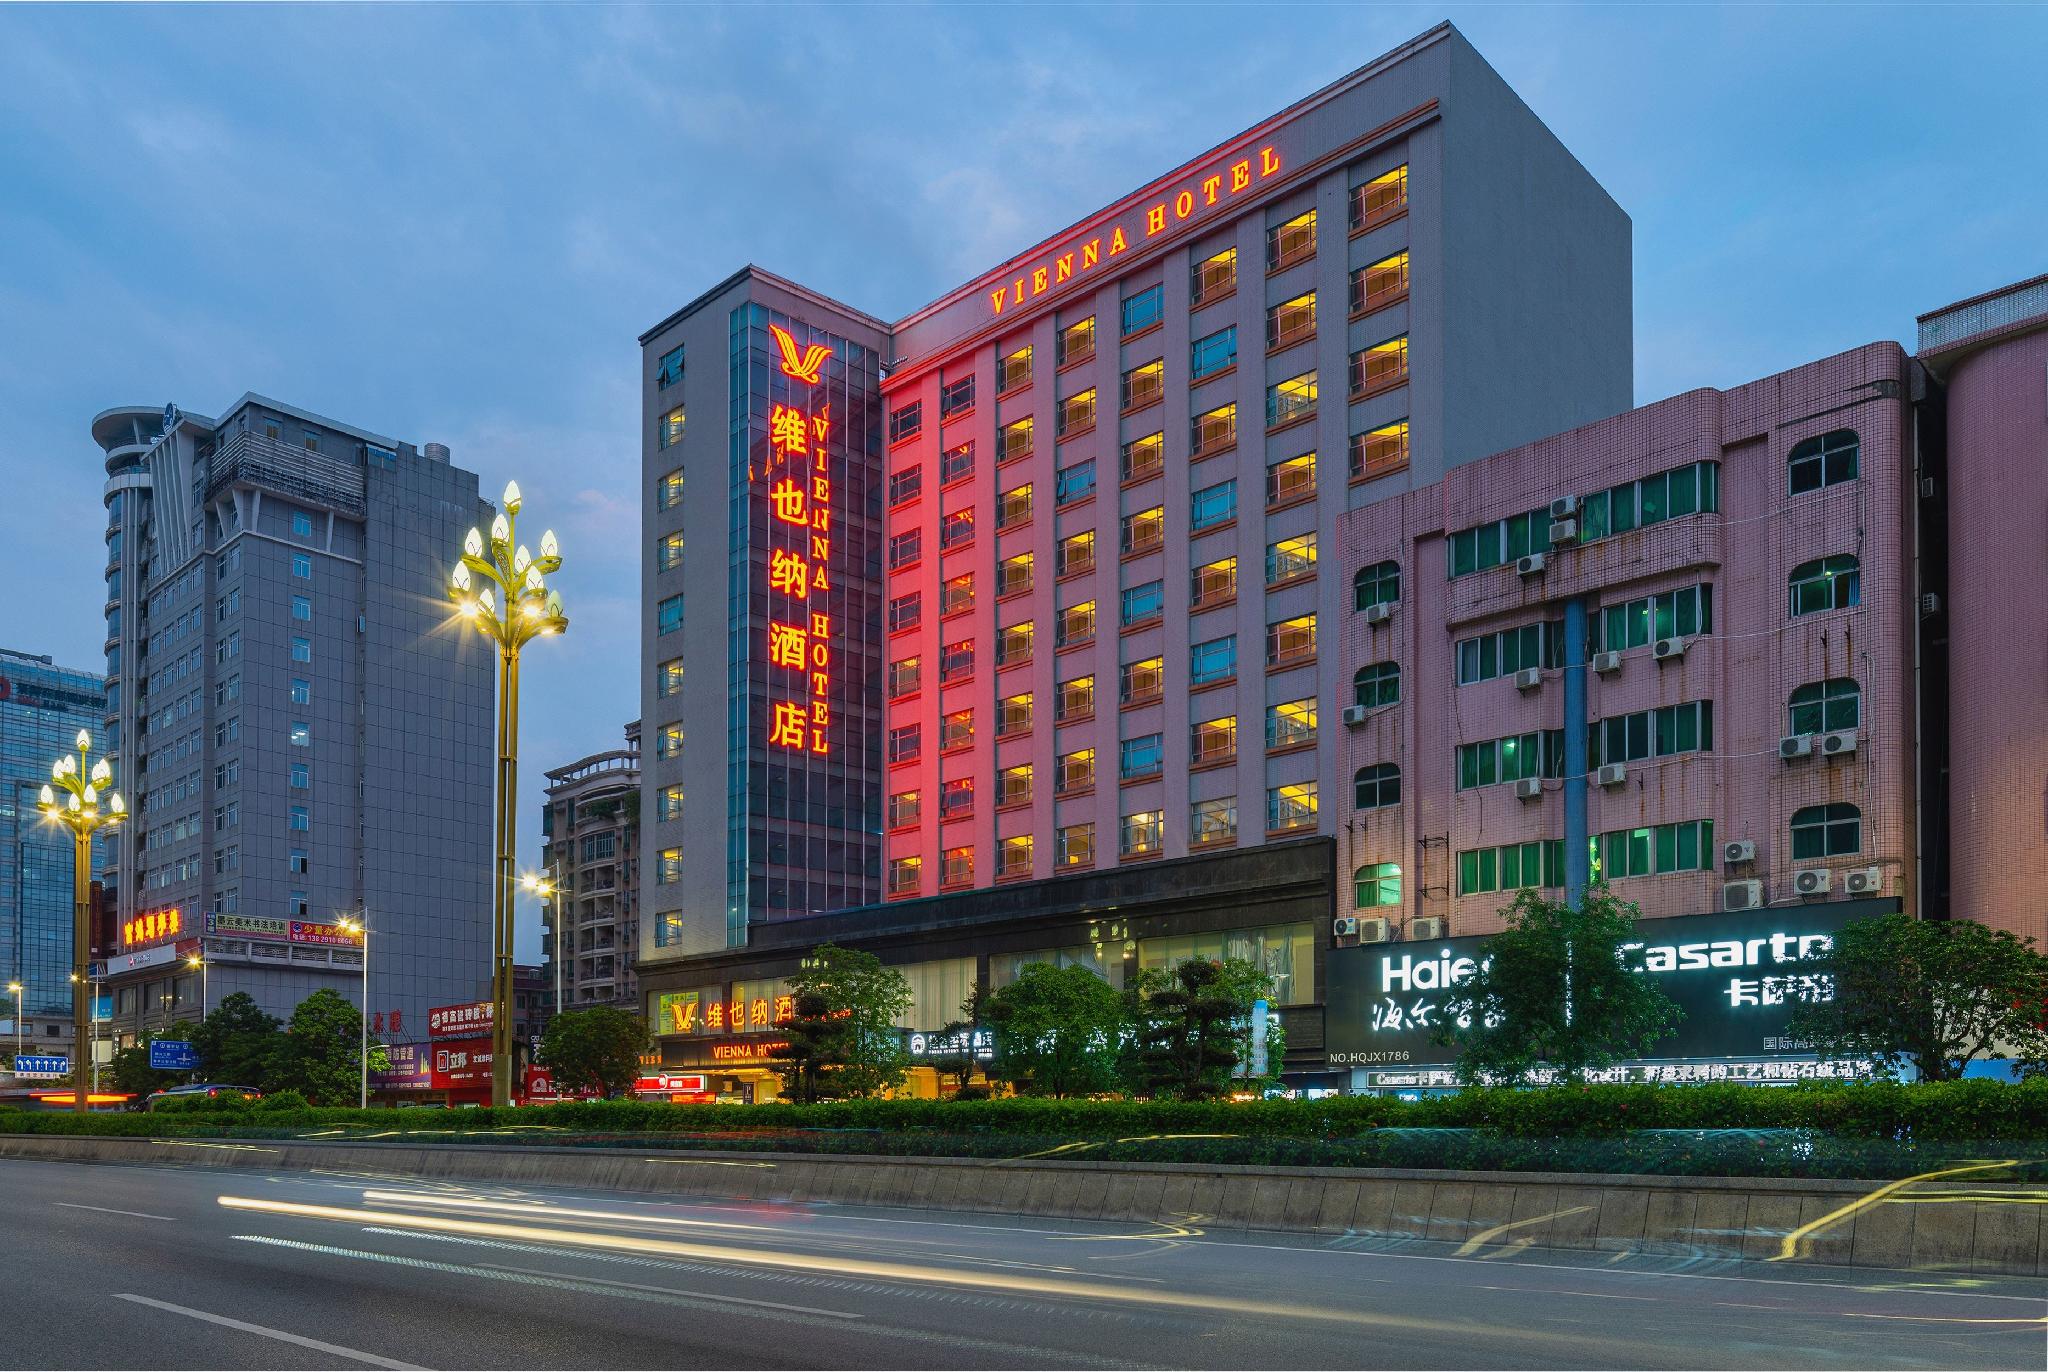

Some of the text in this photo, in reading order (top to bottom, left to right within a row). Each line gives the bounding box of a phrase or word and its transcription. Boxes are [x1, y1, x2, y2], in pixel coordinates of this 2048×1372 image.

[992, 147, 1280, 314] VIENNA HOTEL
[770, 404, 809, 752] 维也纳酒店
[812, 416, 830, 754] VIENNA HOTEL
[1382, 948, 1495, 992] Haie
[707, 995, 794, 1028] 维也纳酒
[713, 1045, 752, 1059] VIENNA
[1330, 1051, 1410, 1064] NO.HQJX1786
